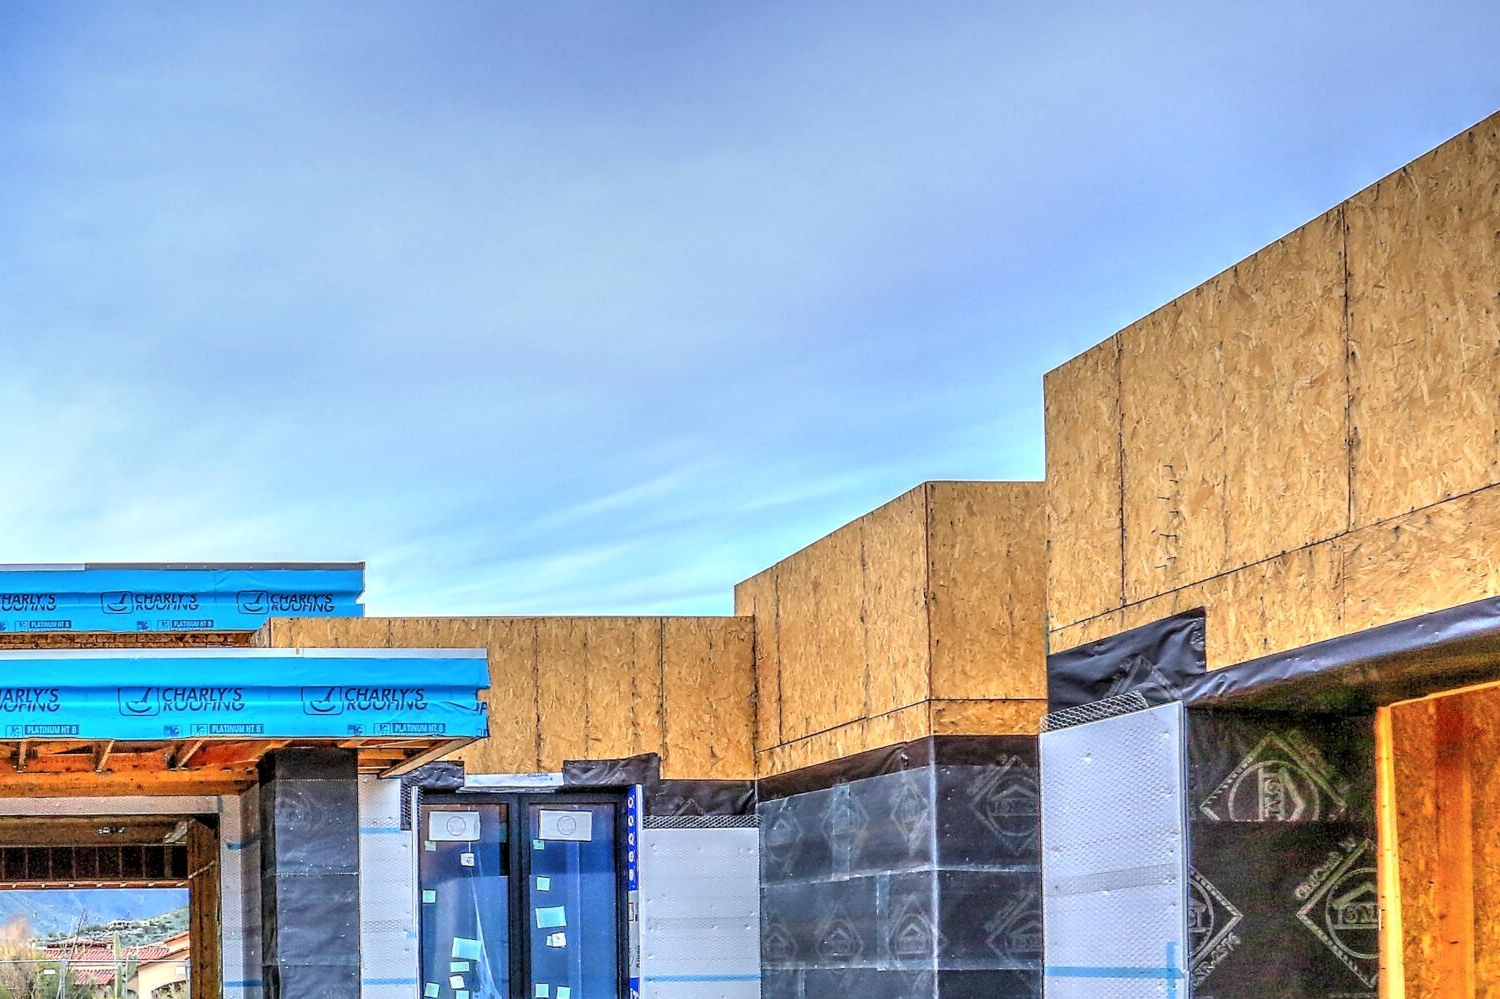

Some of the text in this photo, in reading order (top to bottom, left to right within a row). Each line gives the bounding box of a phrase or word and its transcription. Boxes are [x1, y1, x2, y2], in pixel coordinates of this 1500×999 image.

[135, 593, 198, 604] CHARLY'S
[270, 593, 333, 604] CHARLY'S
[162, 688, 244, 702] CHARLY'S
[344, 688, 426, 702] CHARLY'S
[27, 725, 60, 734] PLATINUM
[212, 724, 245, 733] PLATINUM
[395, 724, 428, 733] PLATINUM
